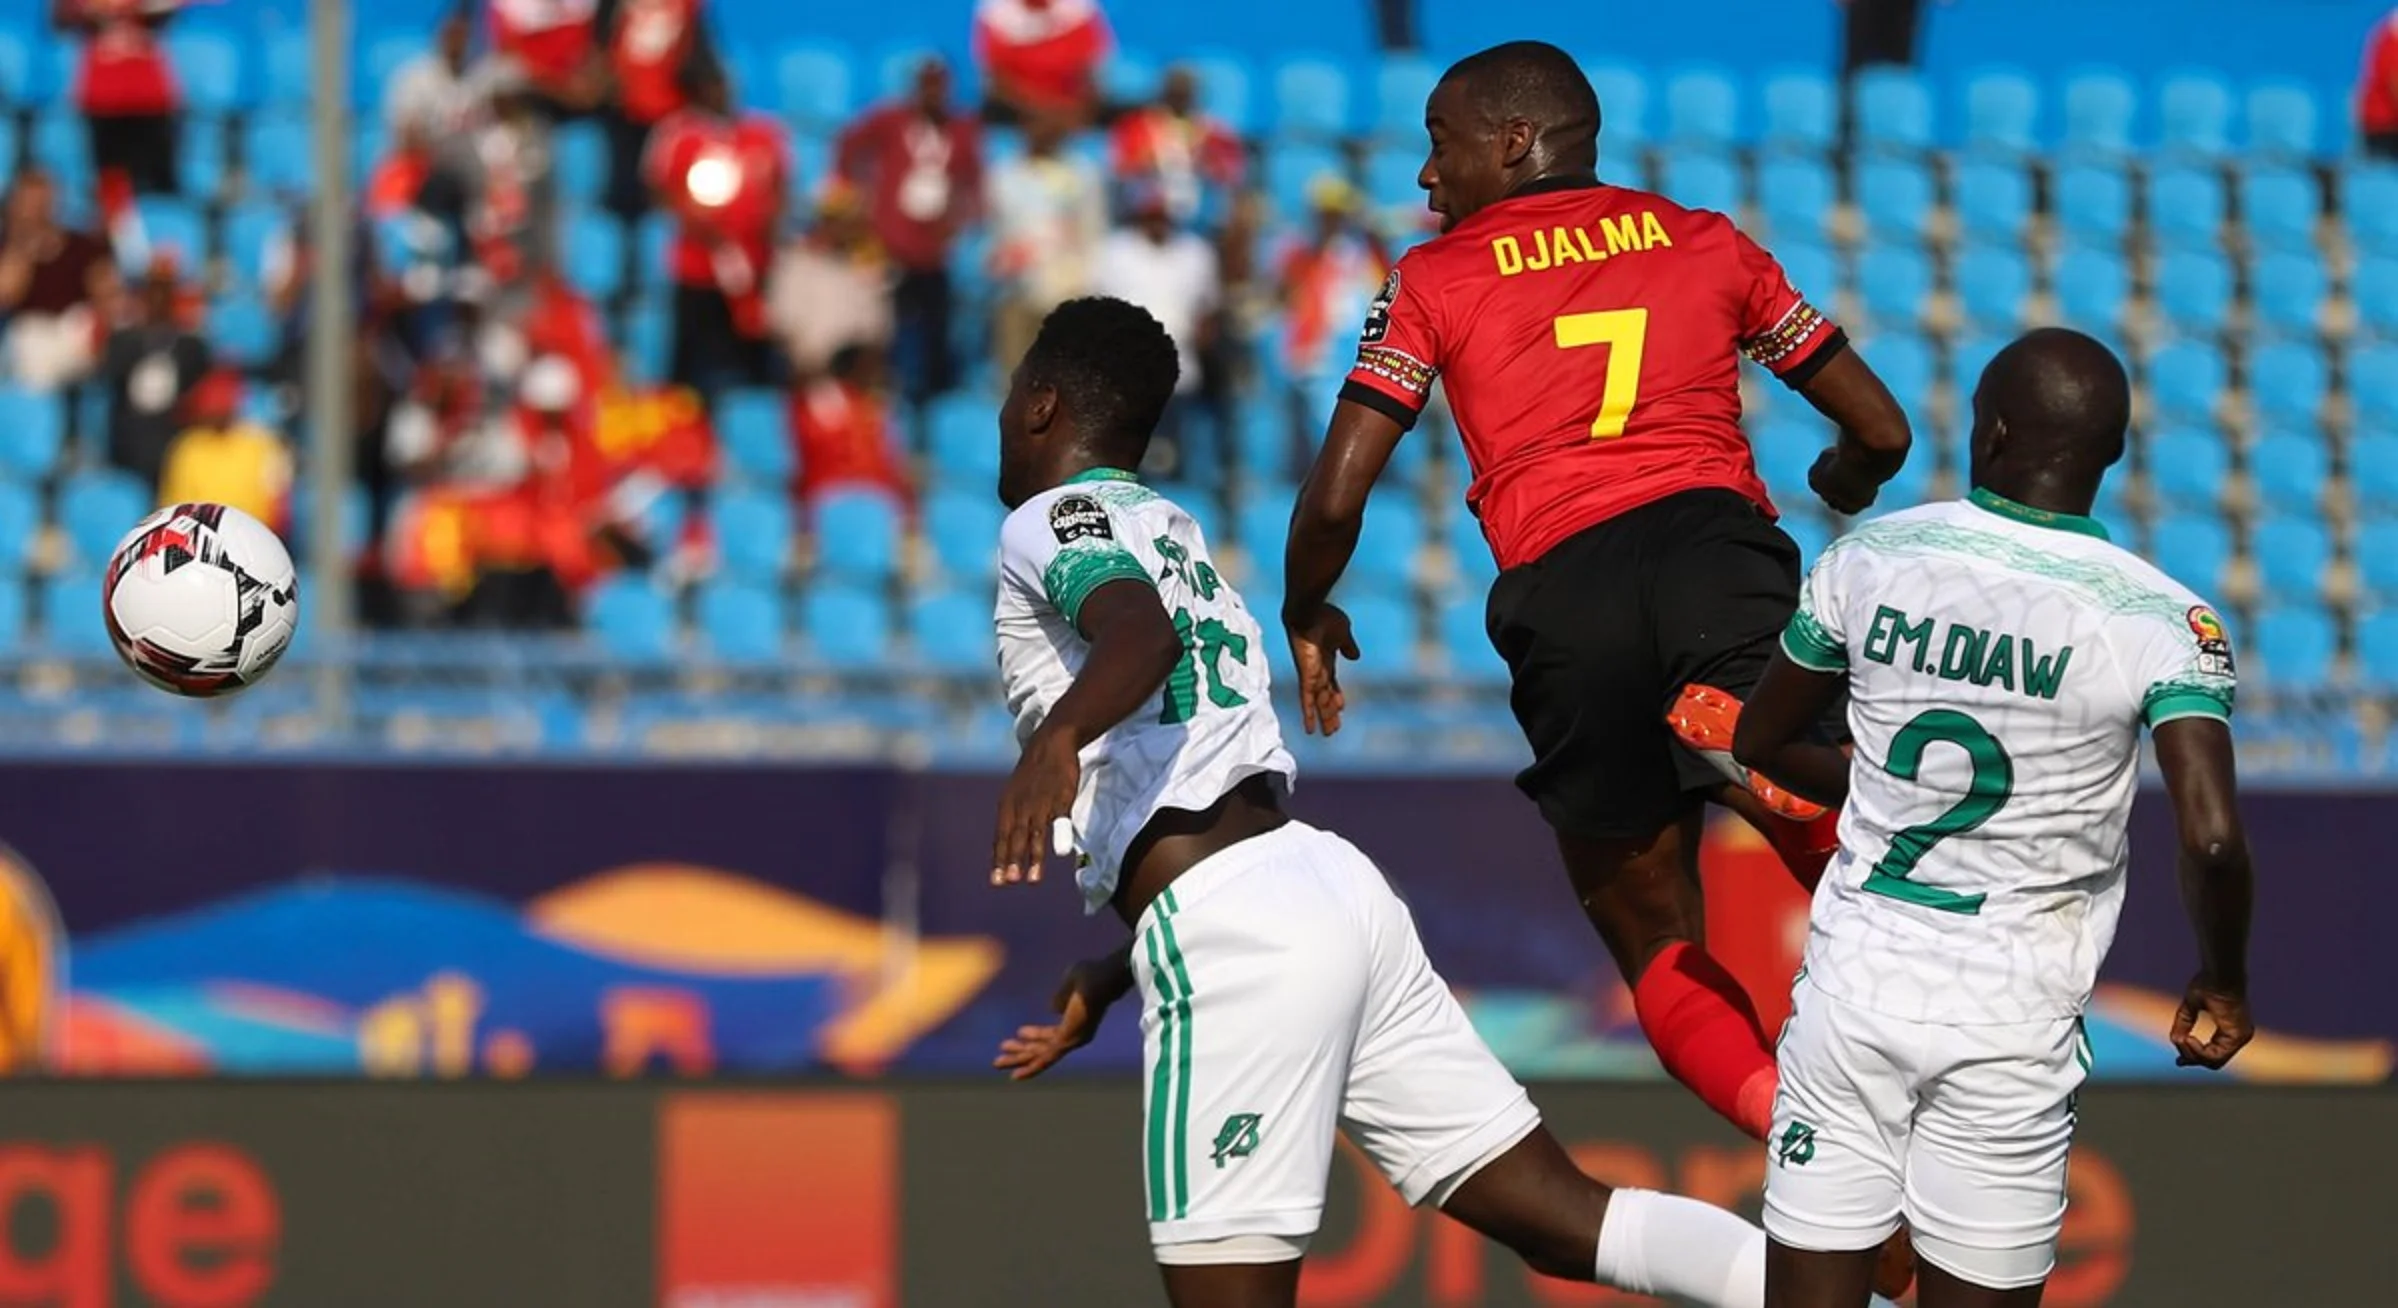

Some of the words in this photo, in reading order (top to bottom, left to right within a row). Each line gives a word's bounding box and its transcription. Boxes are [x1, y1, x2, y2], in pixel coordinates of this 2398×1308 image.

[1491, 210, 1673, 276] DJALMA
[1553, 307, 1649, 439] 7
[1863, 603, 2074, 700] EM.DIAW
[1861, 708, 2014, 916] 2
